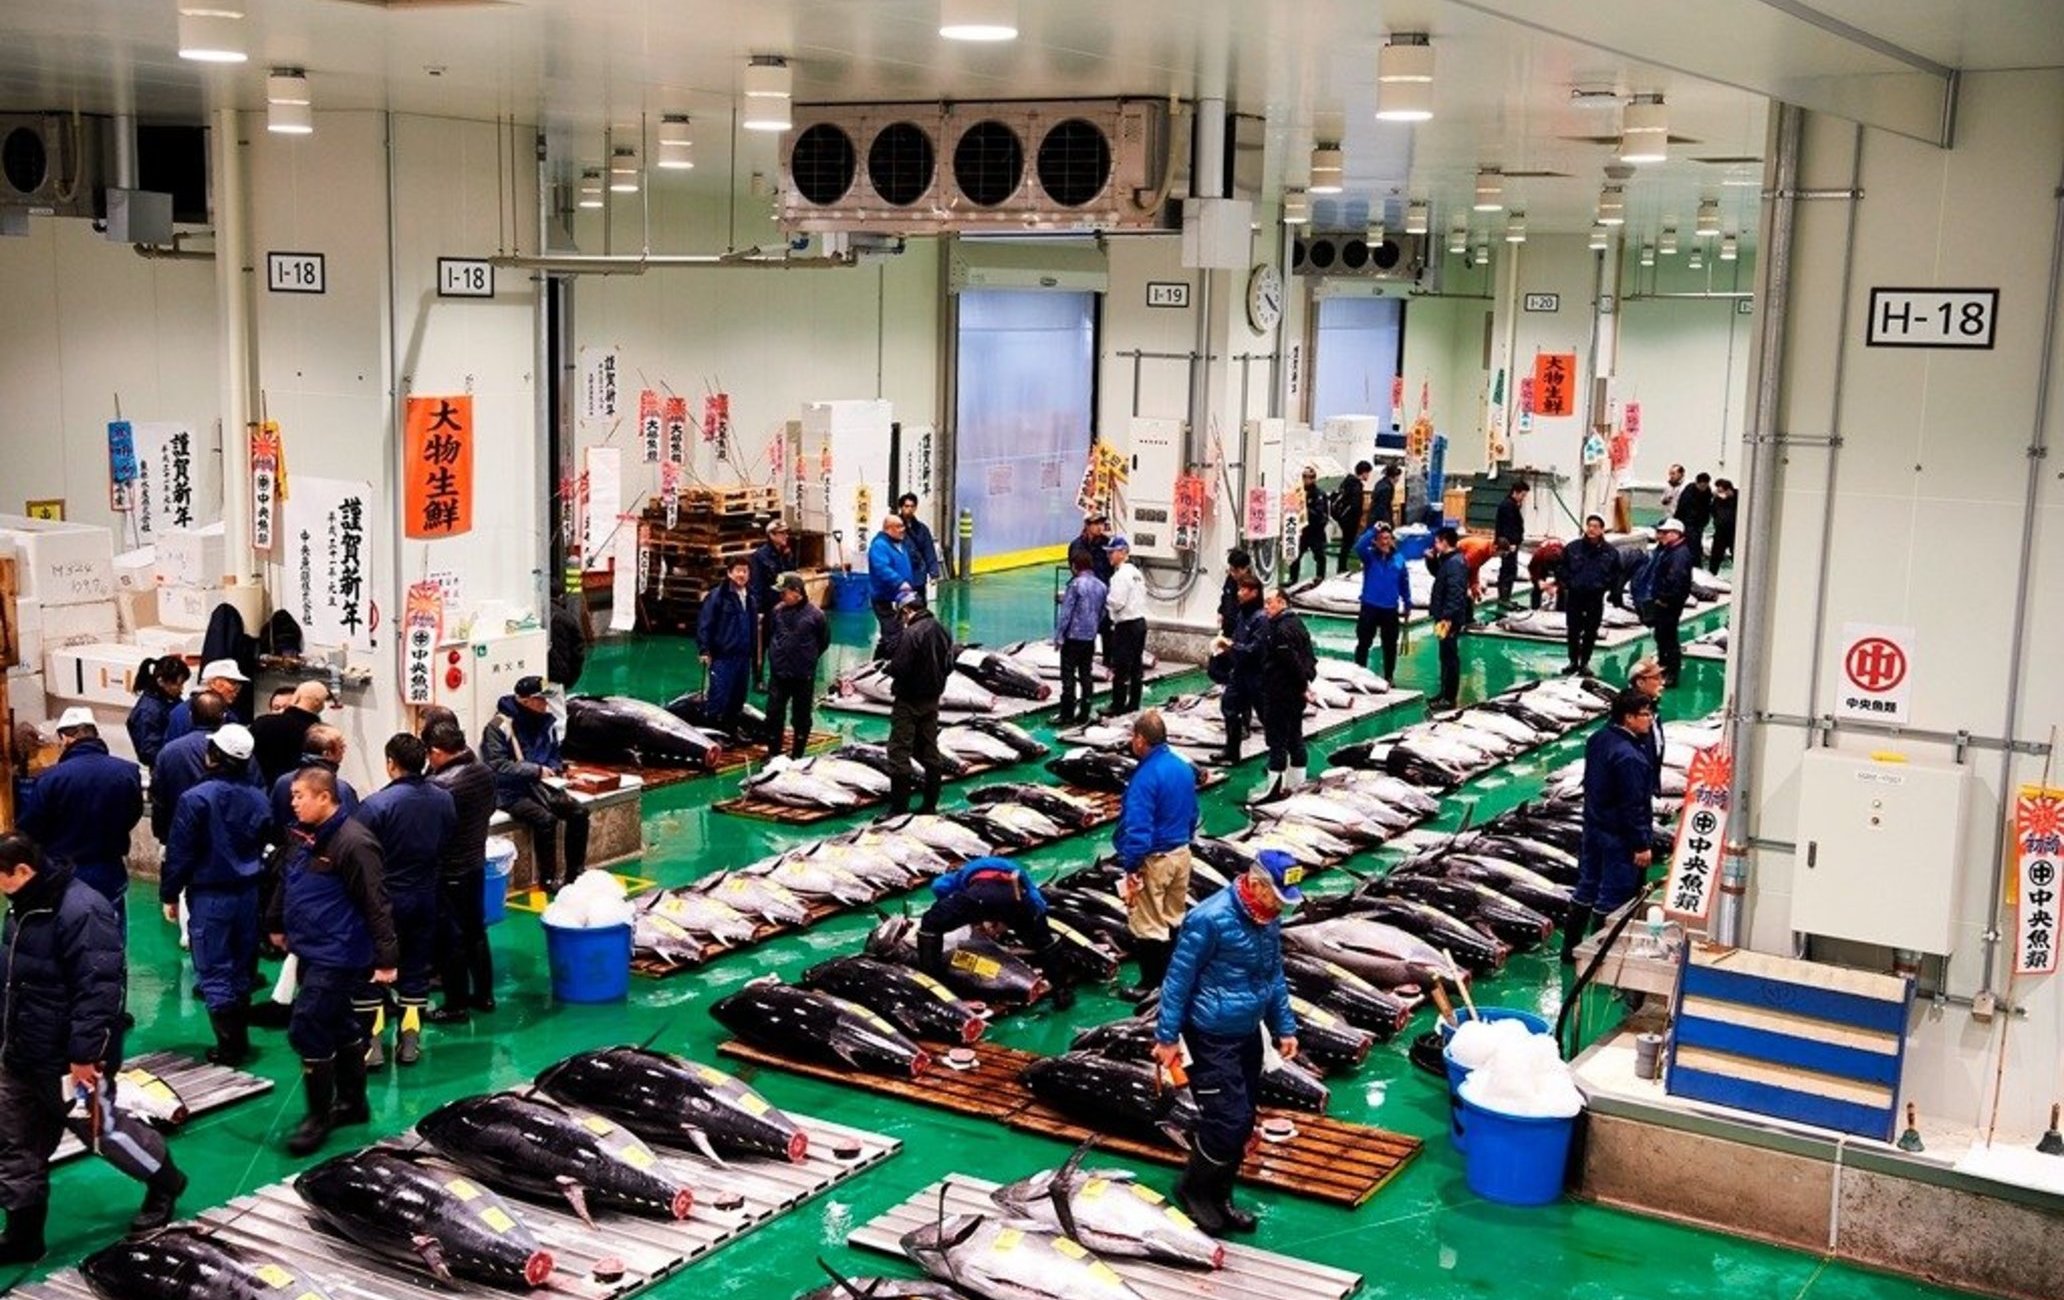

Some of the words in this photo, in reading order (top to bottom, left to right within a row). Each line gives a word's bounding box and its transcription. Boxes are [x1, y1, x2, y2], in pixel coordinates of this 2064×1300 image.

[279, 262, 315, 284] I-18
[448, 267, 484, 289] I-18
[1154, 288, 1182, 302] I-19
[1882, 301, 1985, 336] H-18
[1543, 355, 1564, 415] 大物生鮮
[169, 431, 194, 527] 謹賀新年
[423, 400, 462, 532] 大物生鮮
[339, 497, 363, 636] 謹賀新年
[410, 649, 428, 701] 中央魚類
[1846, 698, 1897, 714] 中央魚類
[1673, 838, 1712, 913] 中央魚類
[2025, 889, 2053, 968] 中央魚類
